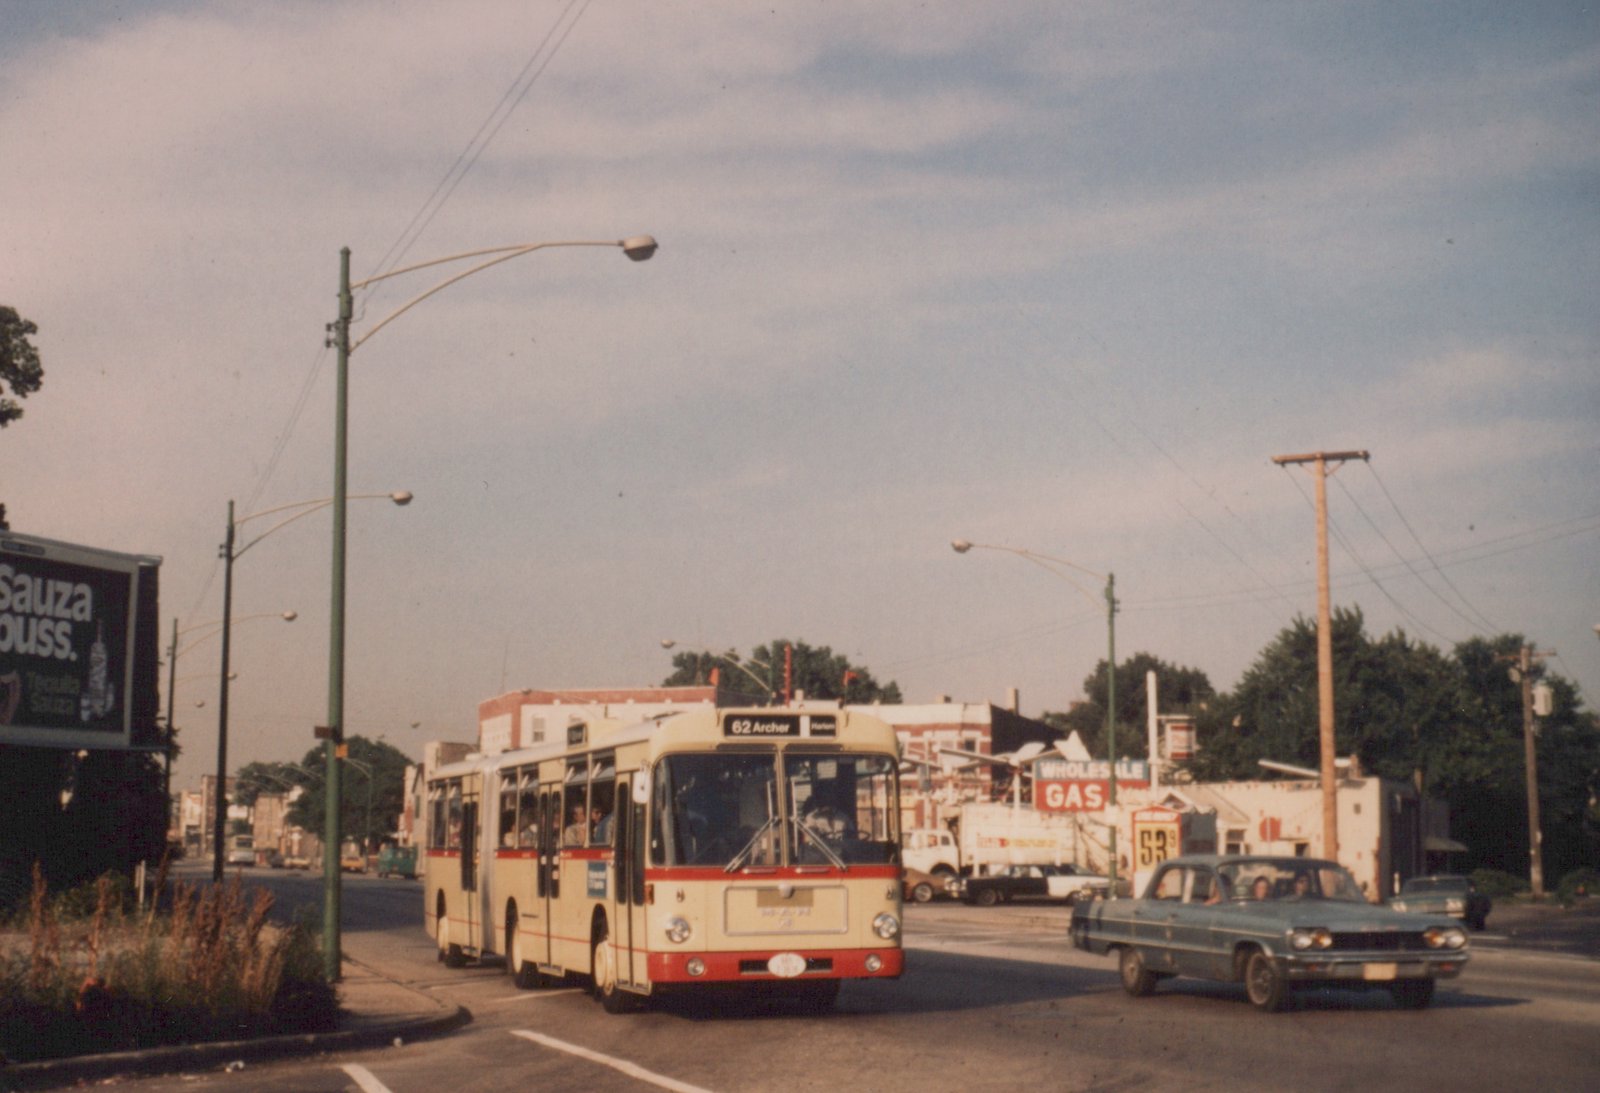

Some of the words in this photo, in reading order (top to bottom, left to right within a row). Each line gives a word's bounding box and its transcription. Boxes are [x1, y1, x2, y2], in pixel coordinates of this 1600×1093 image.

[731, 719, 751, 734] 62
[752, 721, 790, 734] Archer
[1046, 783, 1103, 808] GAS
